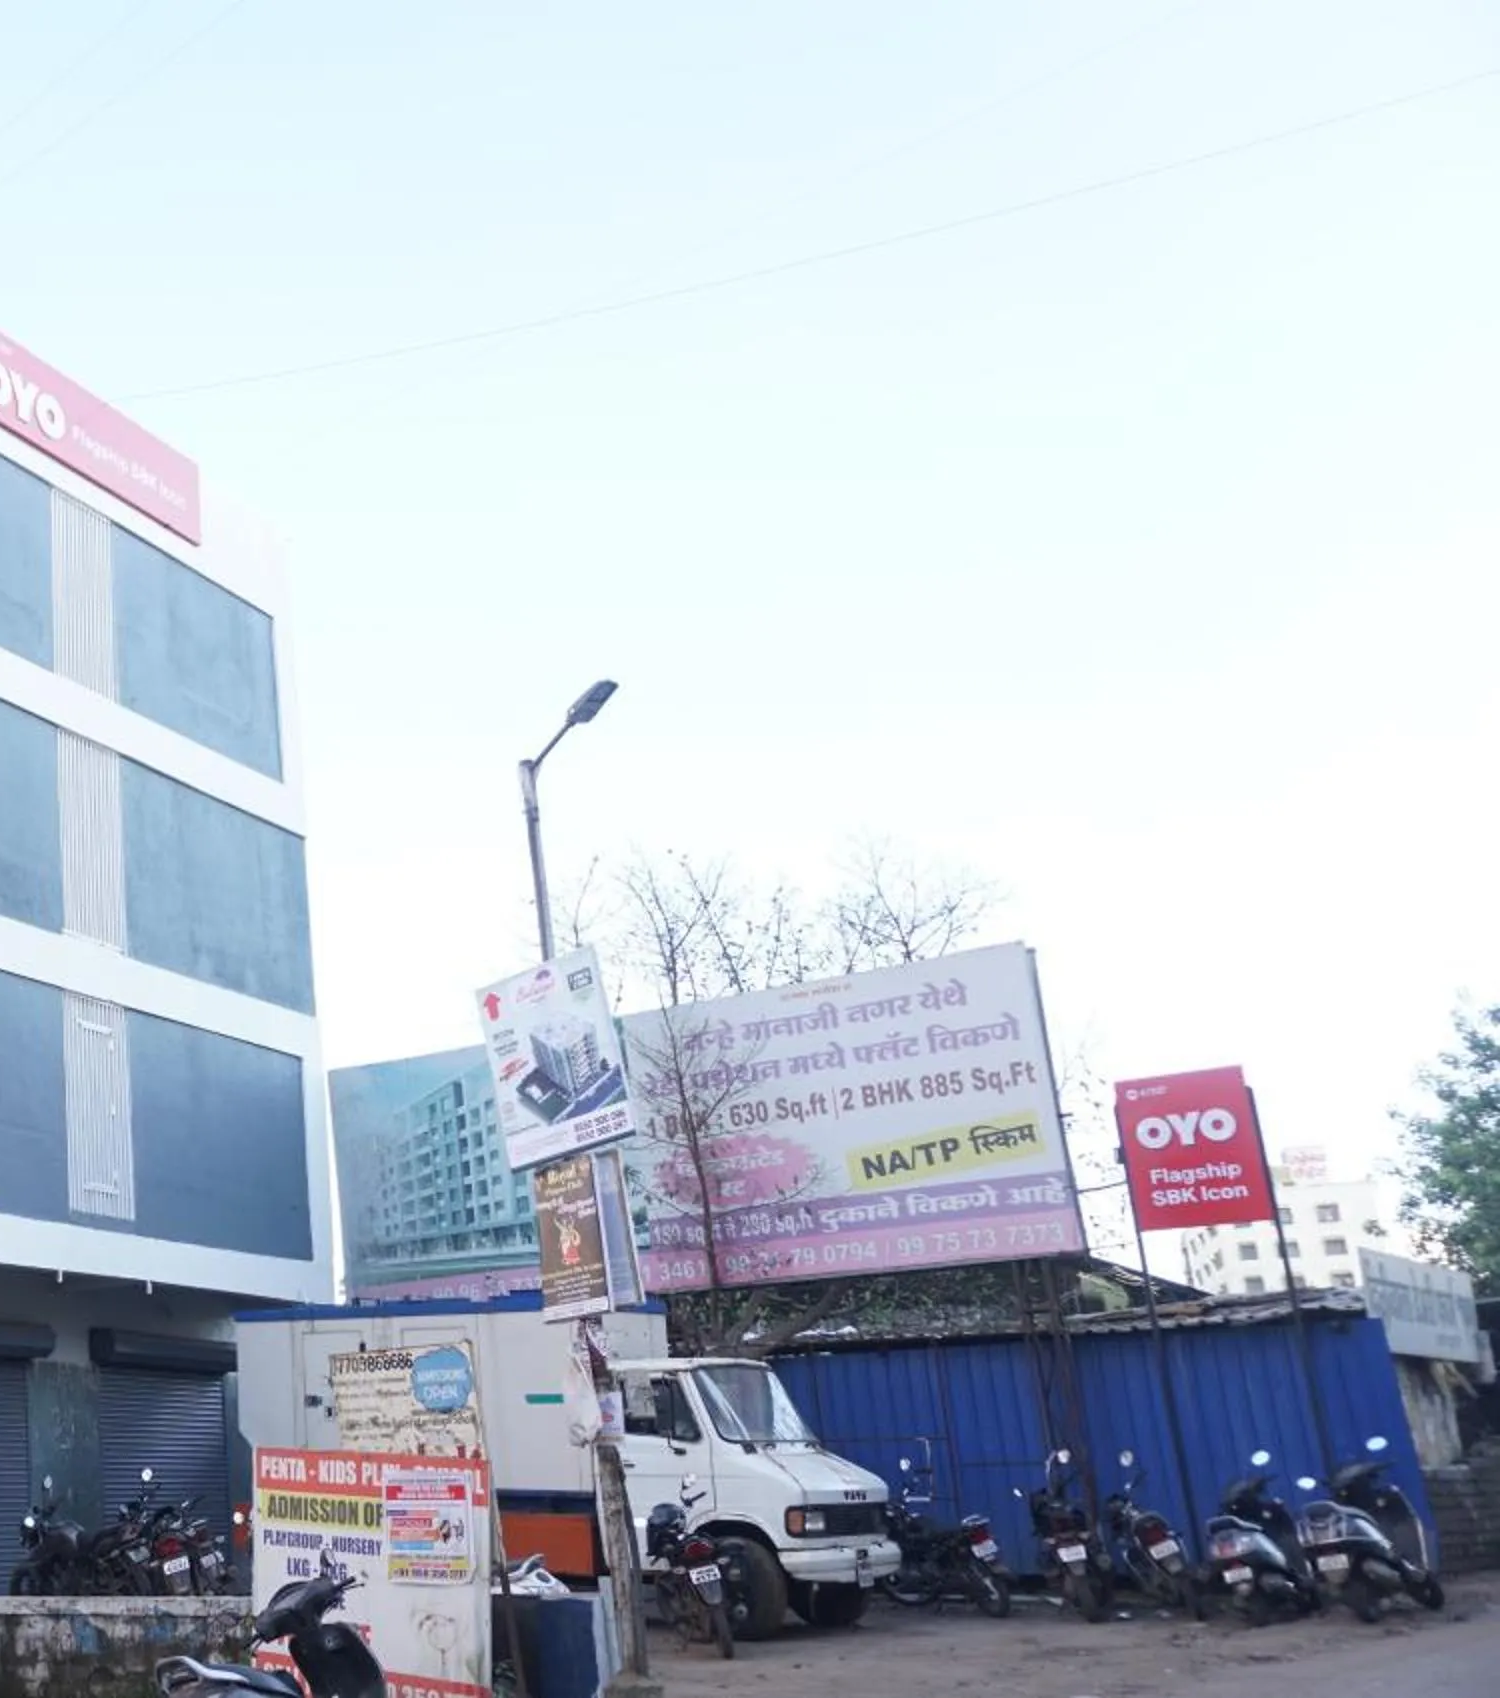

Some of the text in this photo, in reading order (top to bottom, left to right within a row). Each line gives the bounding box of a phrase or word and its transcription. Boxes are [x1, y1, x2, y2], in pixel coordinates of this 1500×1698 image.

[847, 993, 913, 1023] नगर
[916, 978, 968, 1011] येथे
[787, 1041, 846, 1075] मध्ये
[926, 1012, 1021, 1054] विकणे
[730, 1100, 769, 1127] 630
[775, 1091, 828, 1124] Sq.ft
[839, 1087, 856, 1111] 2
[861, 1078, 915, 1109] BHK
[920, 1070, 965, 1100] 885
[970, 1060, 1037, 1095] Sq.Ft
[1136, 1107, 1237, 1149] OYO
[861, 1137, 961, 1180] NA/TP
[1150, 1161, 1243, 1185] Flagship
[906, 1185, 999, 1216] विकणे
[1005, 1177, 1068, 1205] आहे
[1151, 1184, 1250, 1207] SBK Icon
[423, 1385, 458, 1399] OPEN
[261, 1456, 307, 1482] PENTA
[318, 1459, 358, 1485] KIDS
[268, 1494, 359, 1526] ADMISSION
[263, 1529, 323, 1551] PLAYGROUP
[331, 1535, 383, 1557] NURSERY
[287, 1557, 311, 1577] LKG
